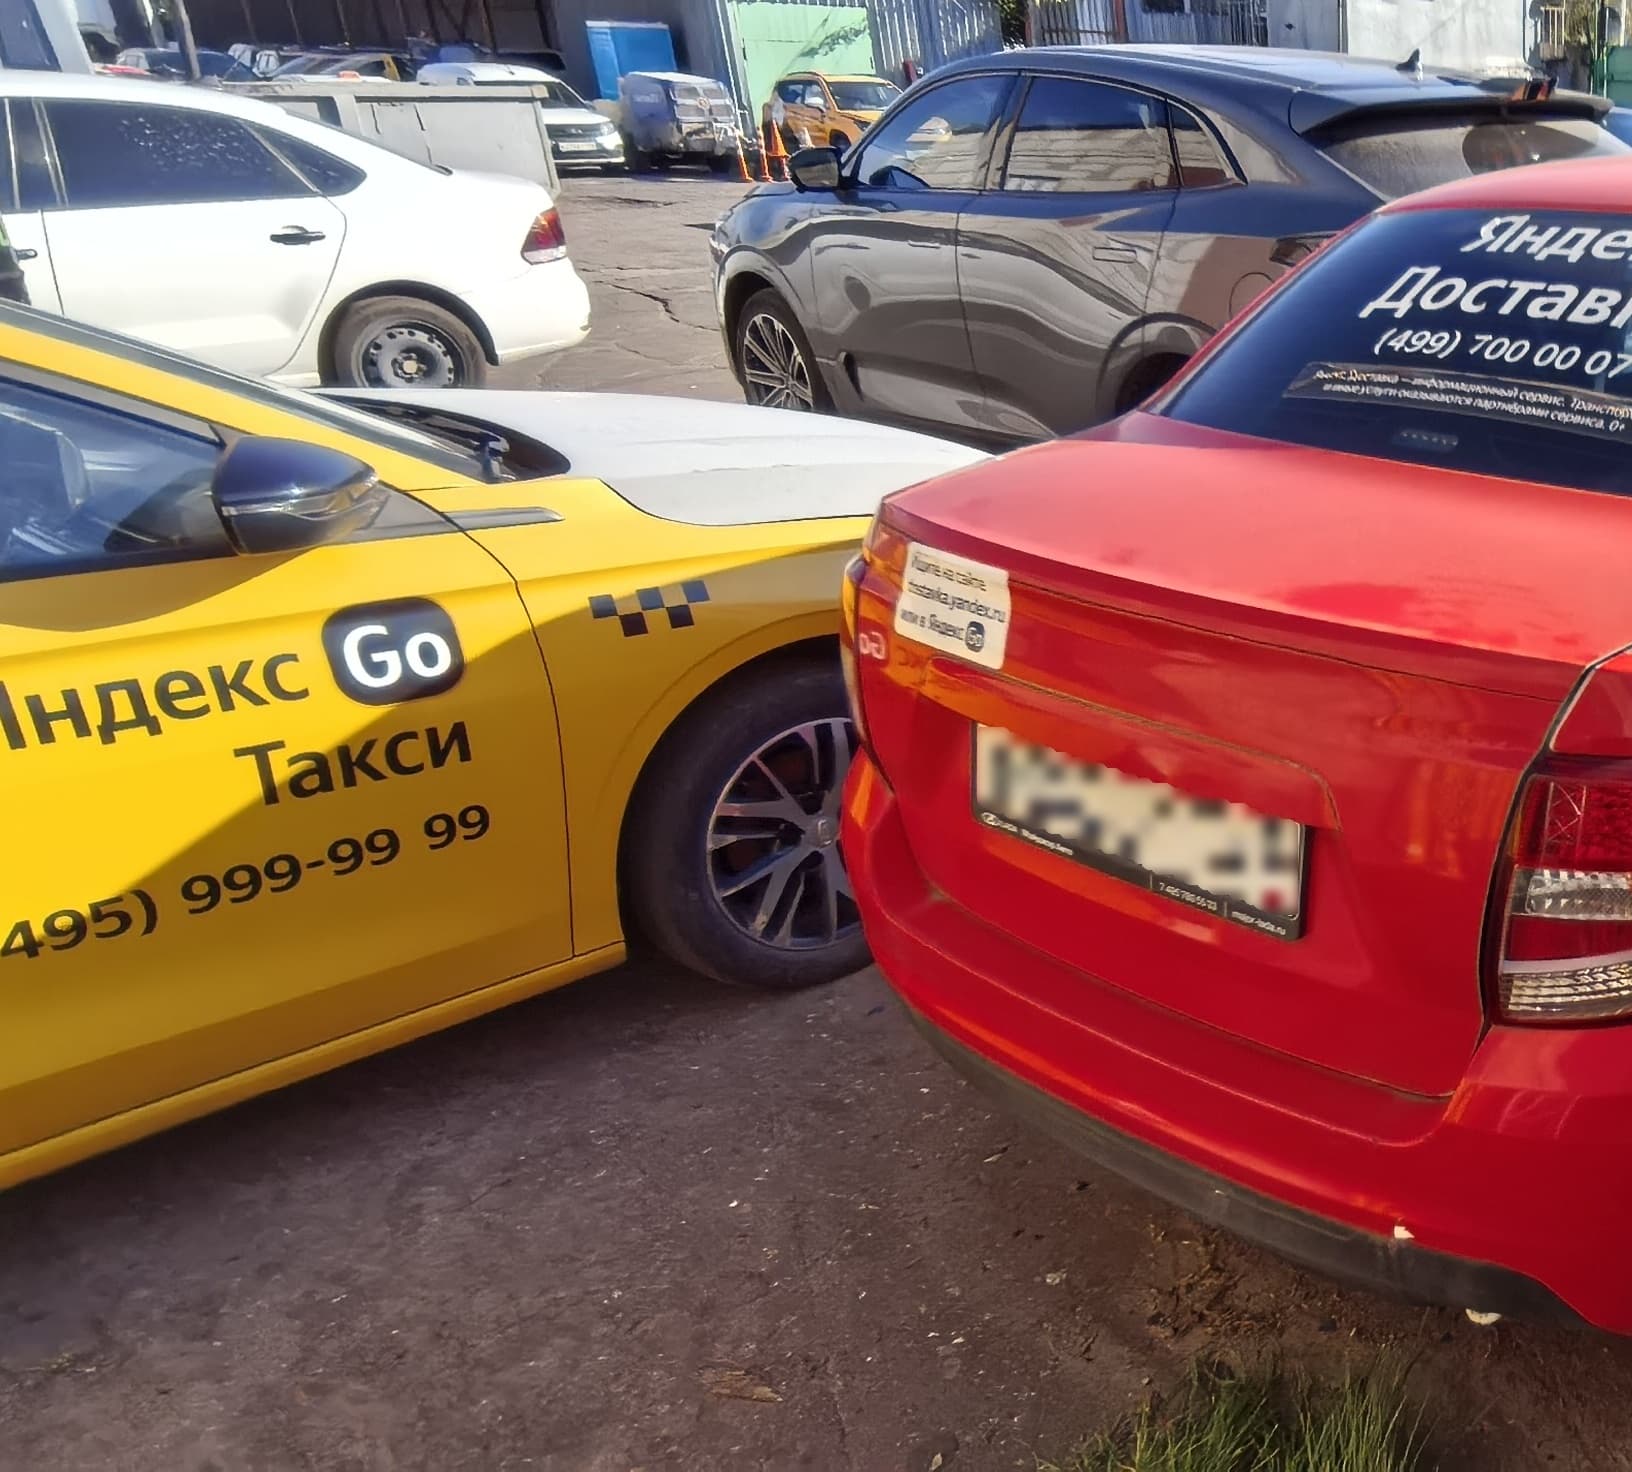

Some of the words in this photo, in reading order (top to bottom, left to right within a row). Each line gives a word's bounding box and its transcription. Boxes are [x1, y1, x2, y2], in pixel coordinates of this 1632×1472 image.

[1374, 328, 1462, 360] (499)
[1469, 334, 1531, 361] 700
[1533, 343, 1582, 371] 00
[343, 624, 452, 688] Go
[234, 720, 472, 806] Такси
[0, 889, 158, 959] 495)
[180, 828, 400, 914] 999-99
[424, 804, 490, 850] 99
